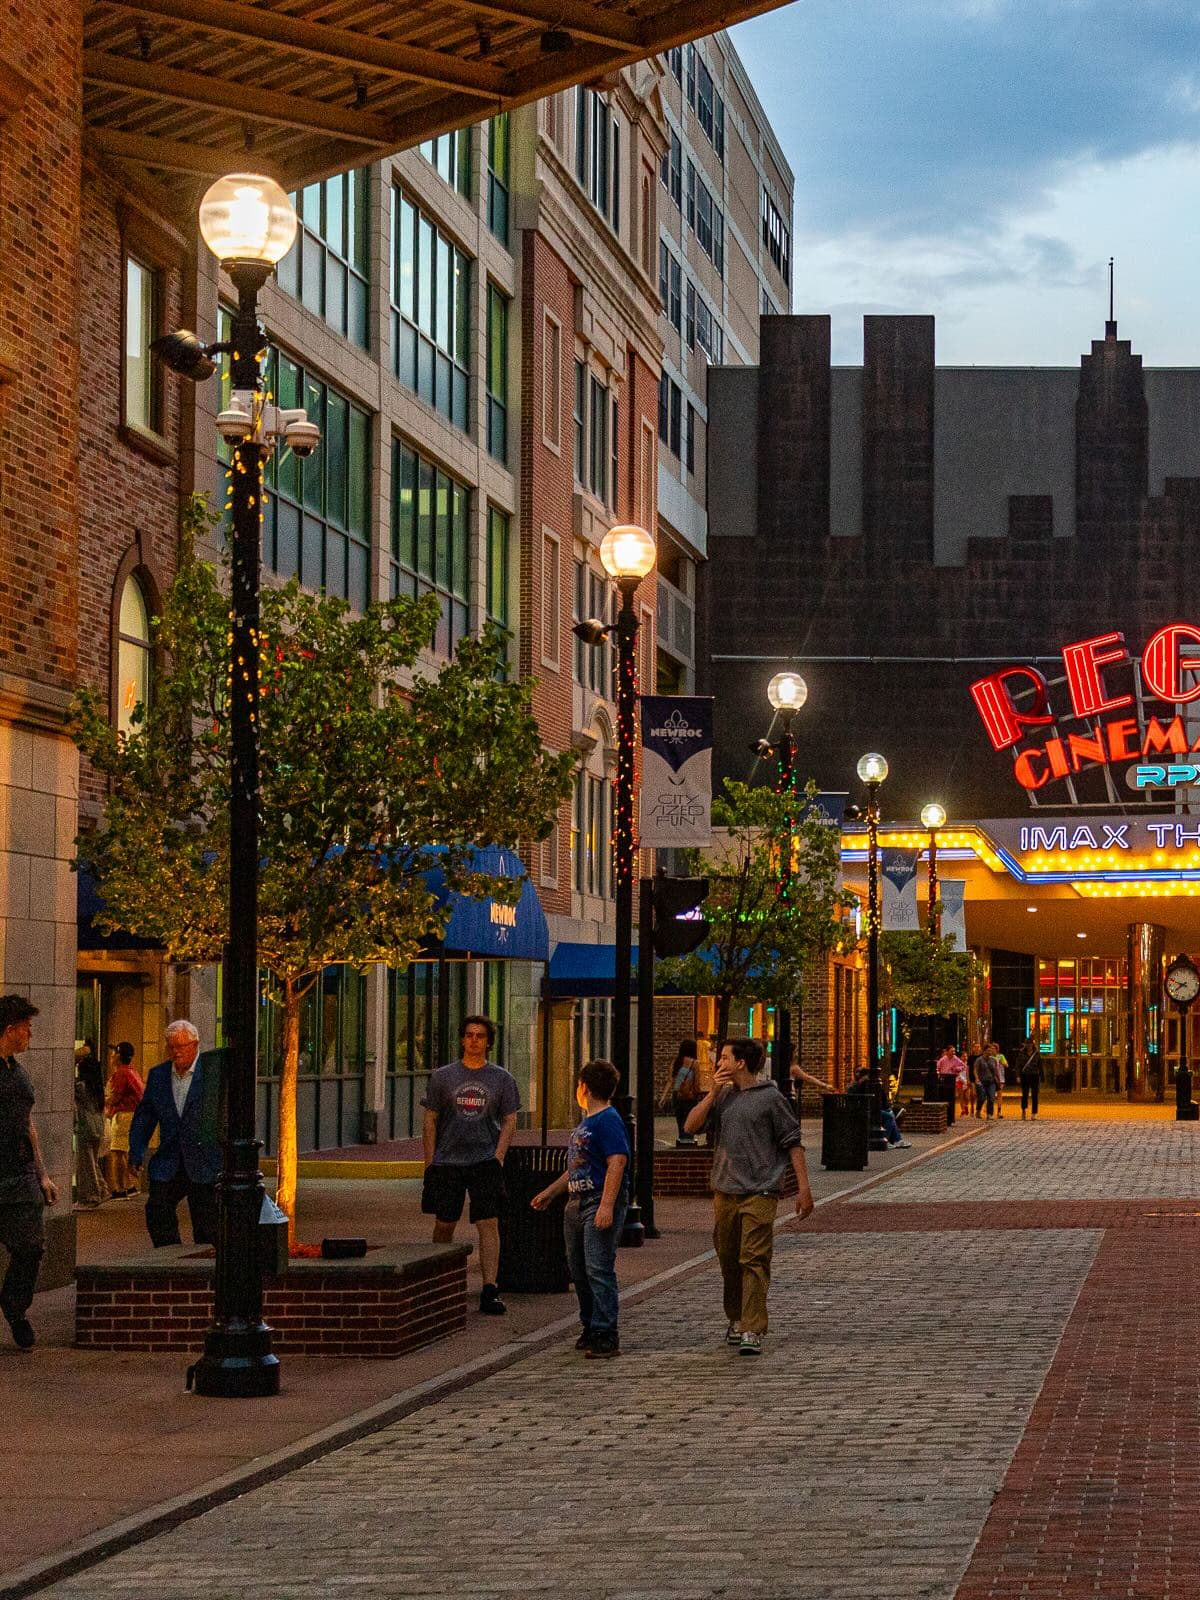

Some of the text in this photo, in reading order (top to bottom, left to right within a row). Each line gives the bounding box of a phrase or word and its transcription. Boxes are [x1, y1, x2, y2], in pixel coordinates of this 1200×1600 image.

[650, 728, 702, 737] NEWROC
[658, 794, 700, 805] CITY
[647, 804, 704, 816] SIZED
[656, 816, 696, 827] FUN
[1019, 824, 1130, 851] IMAX
[490, 902, 516, 927] NEWROC
